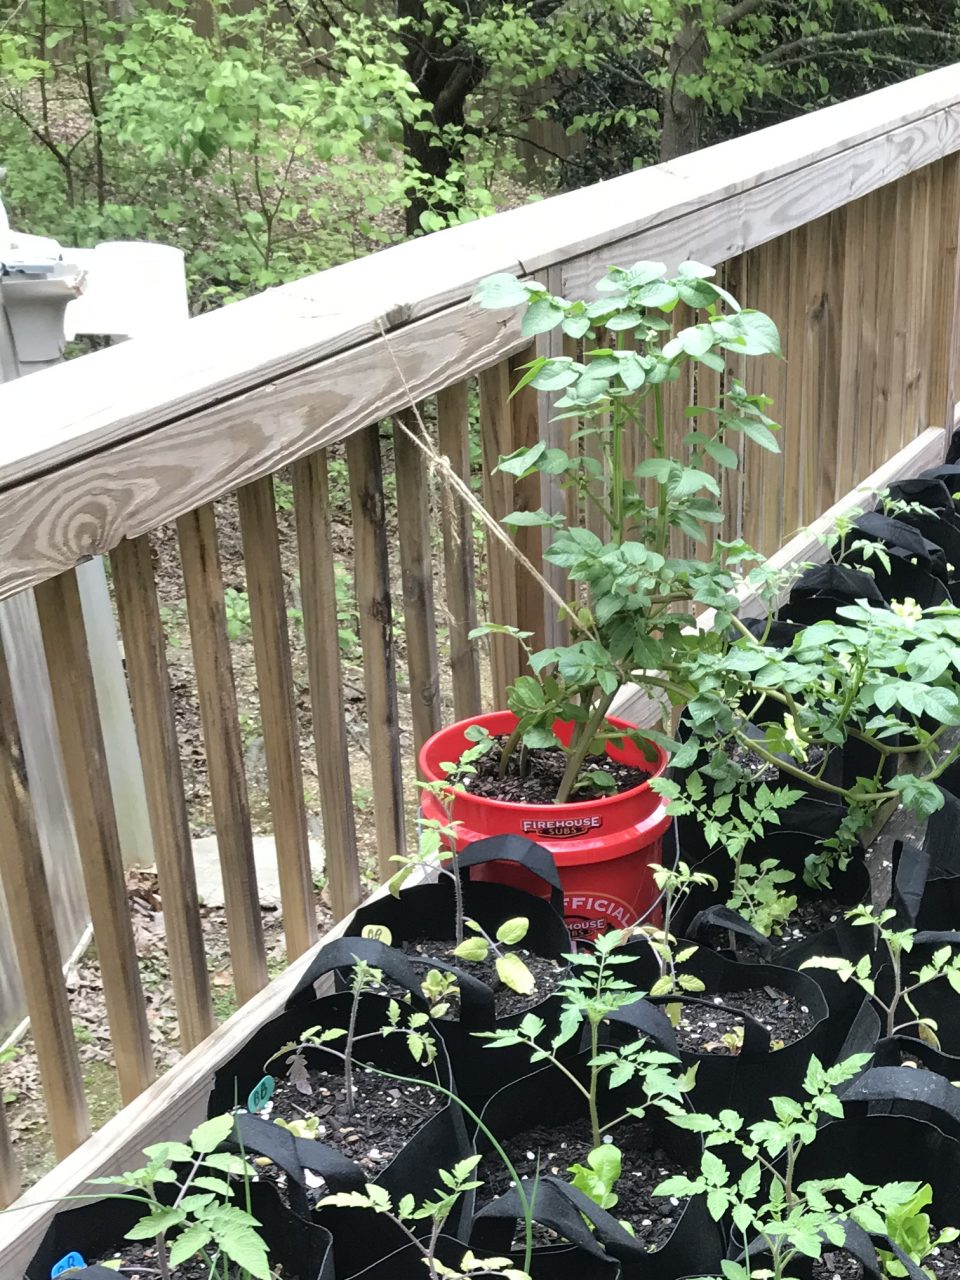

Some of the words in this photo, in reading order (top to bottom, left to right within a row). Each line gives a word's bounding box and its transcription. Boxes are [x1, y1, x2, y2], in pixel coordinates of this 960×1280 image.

[523, 816, 600, 832] FIREHOUSE
[549, 827, 577, 835] SUBS
[566, 918, 605, 930] HOUSE
